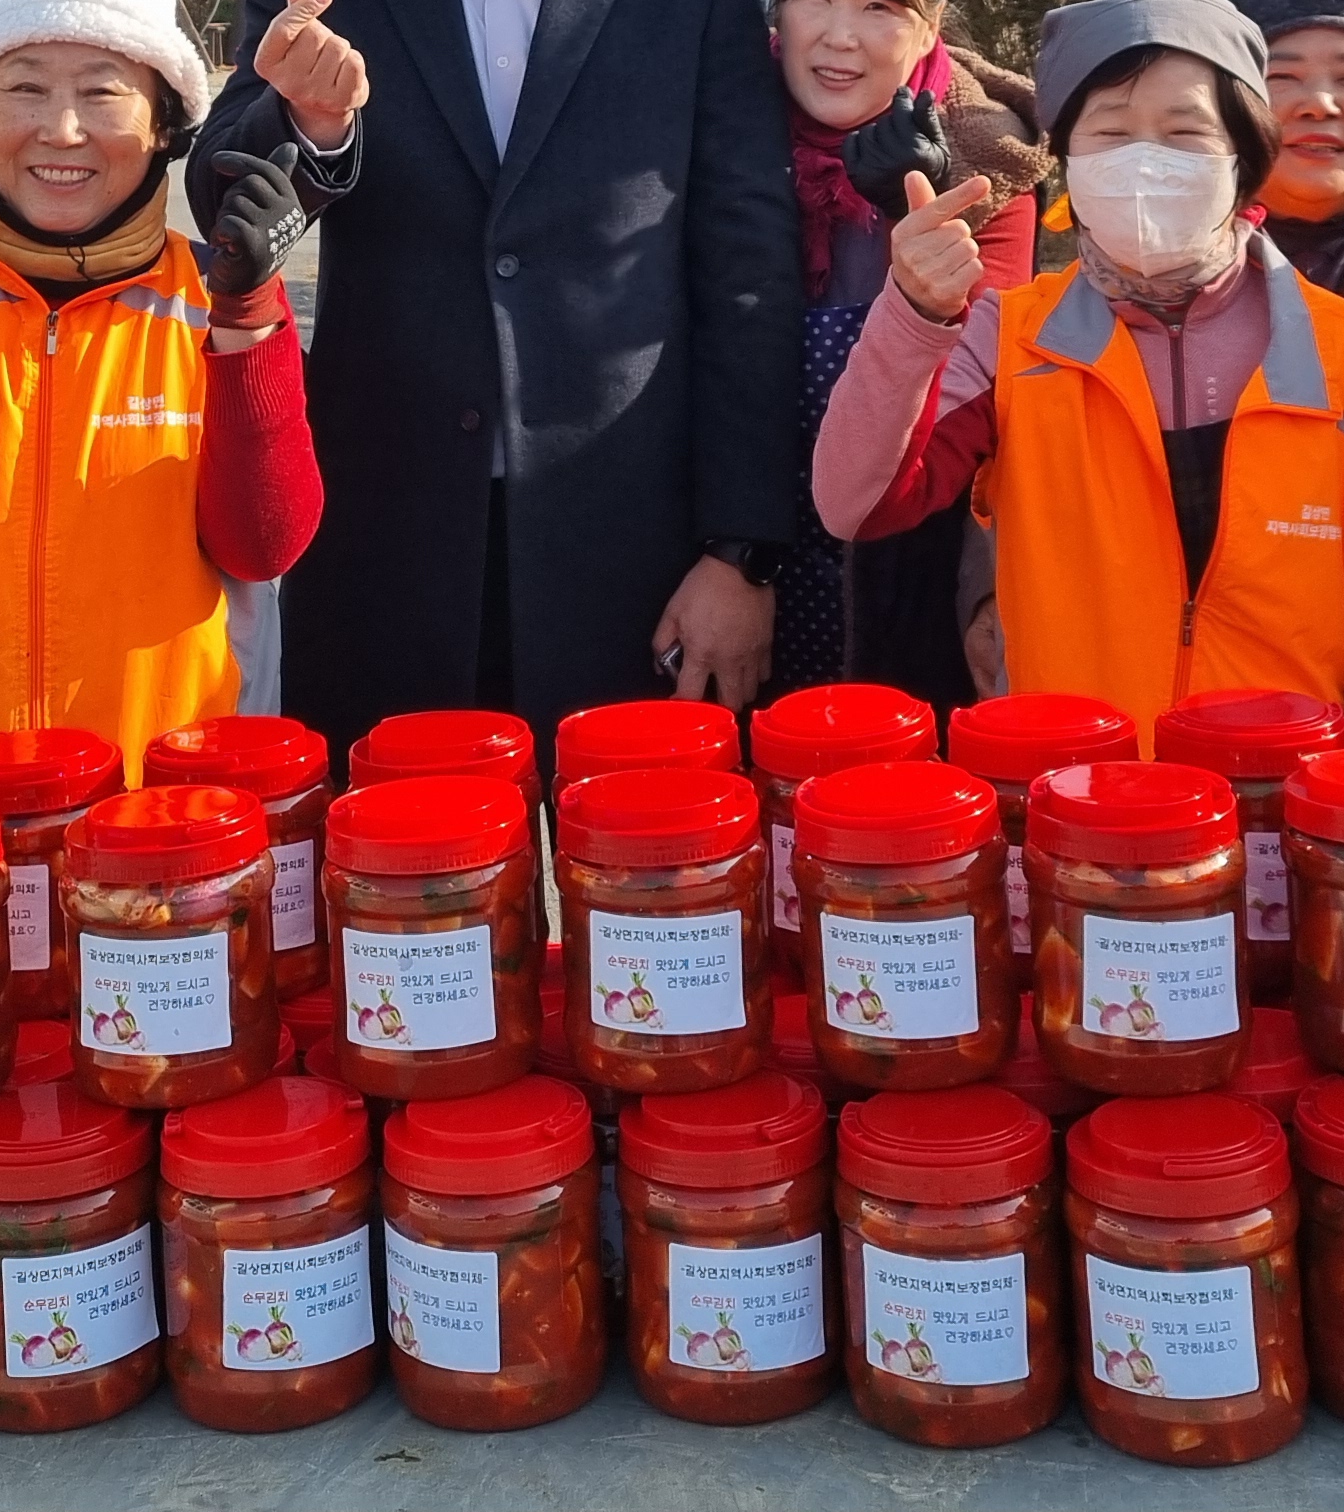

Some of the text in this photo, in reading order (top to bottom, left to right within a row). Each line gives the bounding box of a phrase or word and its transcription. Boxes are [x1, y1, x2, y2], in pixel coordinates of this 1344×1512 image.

[127, 393, 165, 411] 길상면
[10, 910, 30, 919] 시고
[608, 955, 725, 971] 순무김치 맛있게 드시고
[837, 956, 955, 974] 순무김치 맛있게 드시고
[358, 970, 473, 987] 순무김치 맛있게 드시고
[667, 974, 721, 988] 건강하세요
[1106, 966, 1223, 983] 순무김치 맛있게 드시고
[95, 977, 209, 993] 순무김치 맛있게 드시고
[894, 979, 950, 992] 건강하세요
[1169, 986, 1218, 1001] 건강하세요
[148, 996, 203, 1011] 건강하세요
[413, 989, 468, 1004] 건강하세요
[24, 1270, 140, 1311] 순무김치 맛있게 드시고
[243, 1272, 358, 1304] 순무김치 맛있게 드시고
[88, 1290, 138, 1320] 건강하세요
[306, 1292, 354, 1317] 건강하세요
[413, 1290, 478, 1313] 맛있게 드시고
[691, 1287, 810, 1310] 순무김치 맛있게 드시고
[422, 1311, 472, 1331] 건강하세요
[754, 1306, 805, 1327] 건강하세요
[884, 1302, 1009, 1324] 순무김치 맛있게 드시고
[1105, 1312, 1231, 1335] 순무김치 맛있게 드시고
[945, 1328, 1004, 1343] 건강하세요
[1166, 1341, 1227, 1355] 건강하세요
